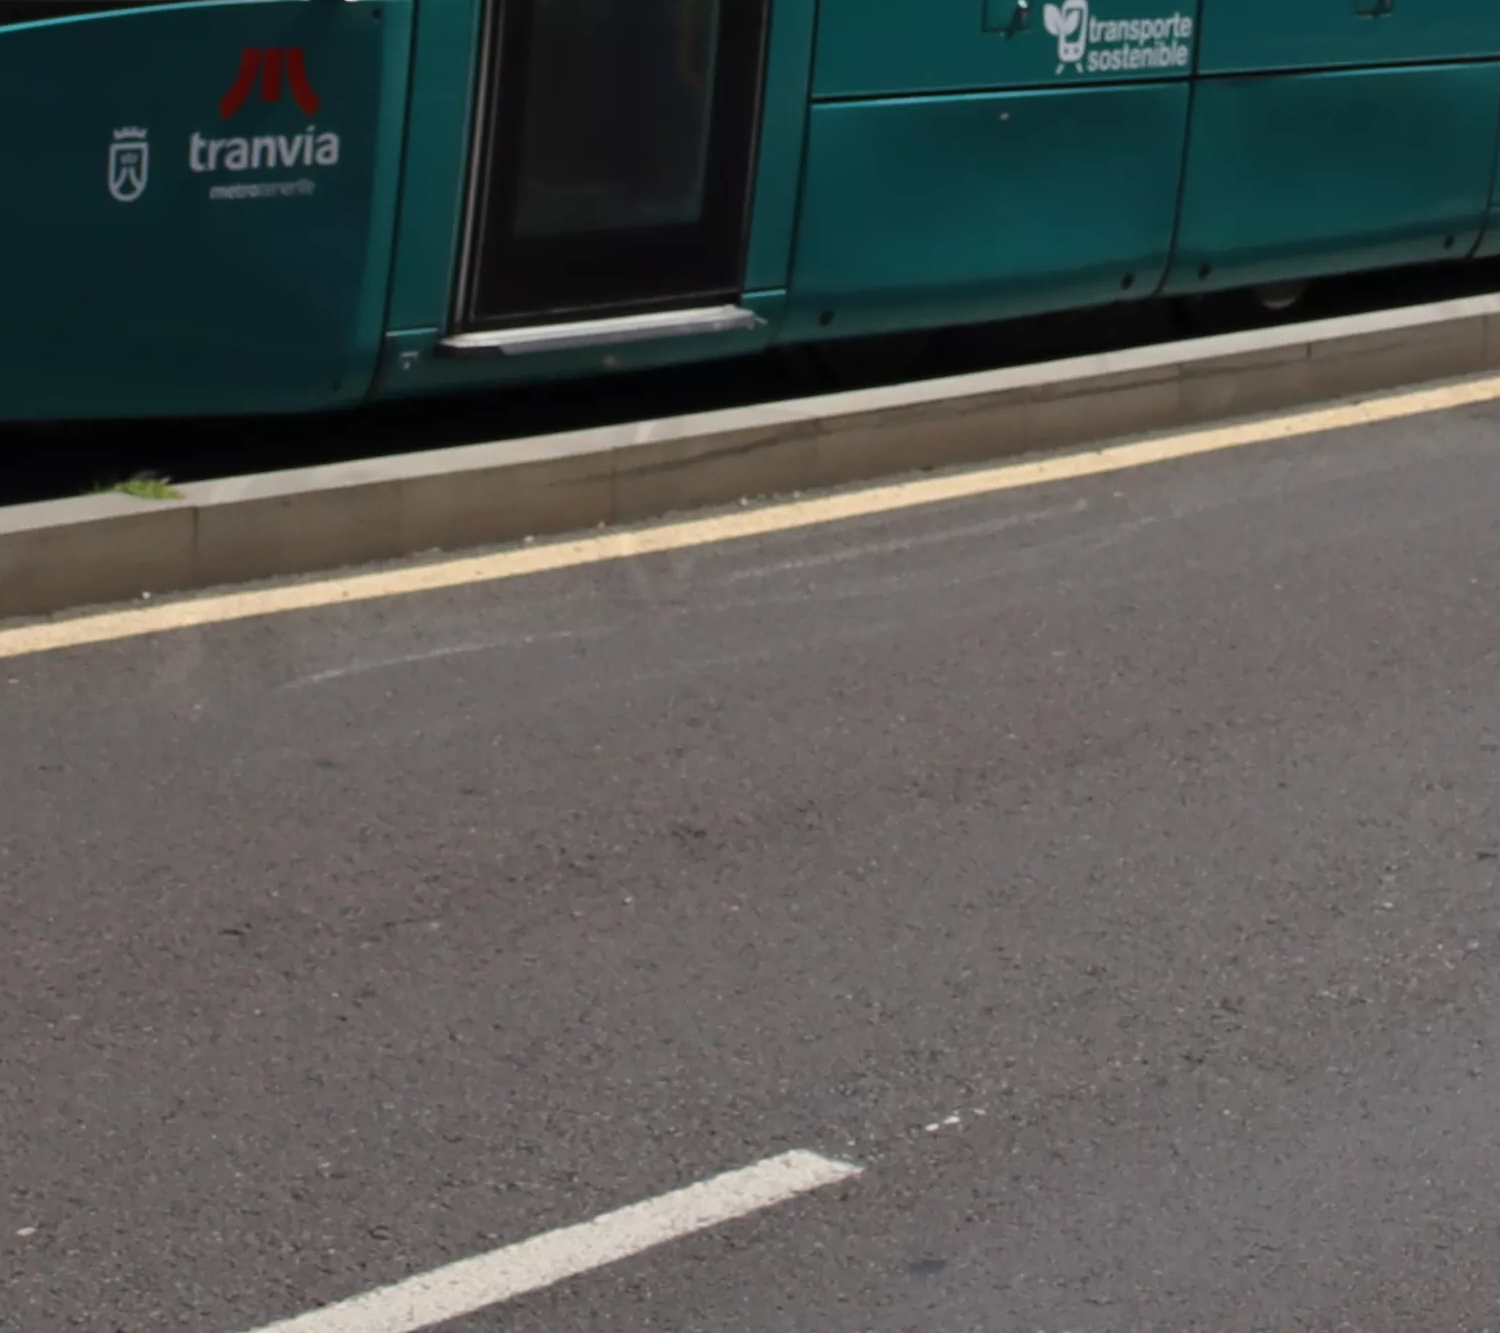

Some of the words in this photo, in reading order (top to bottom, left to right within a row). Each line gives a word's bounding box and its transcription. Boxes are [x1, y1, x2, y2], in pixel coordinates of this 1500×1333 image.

[1087, 10, 1193, 46] transporte
[1087, 43, 1189, 72] sostenible
[189, 124, 340, 172] tranvía
